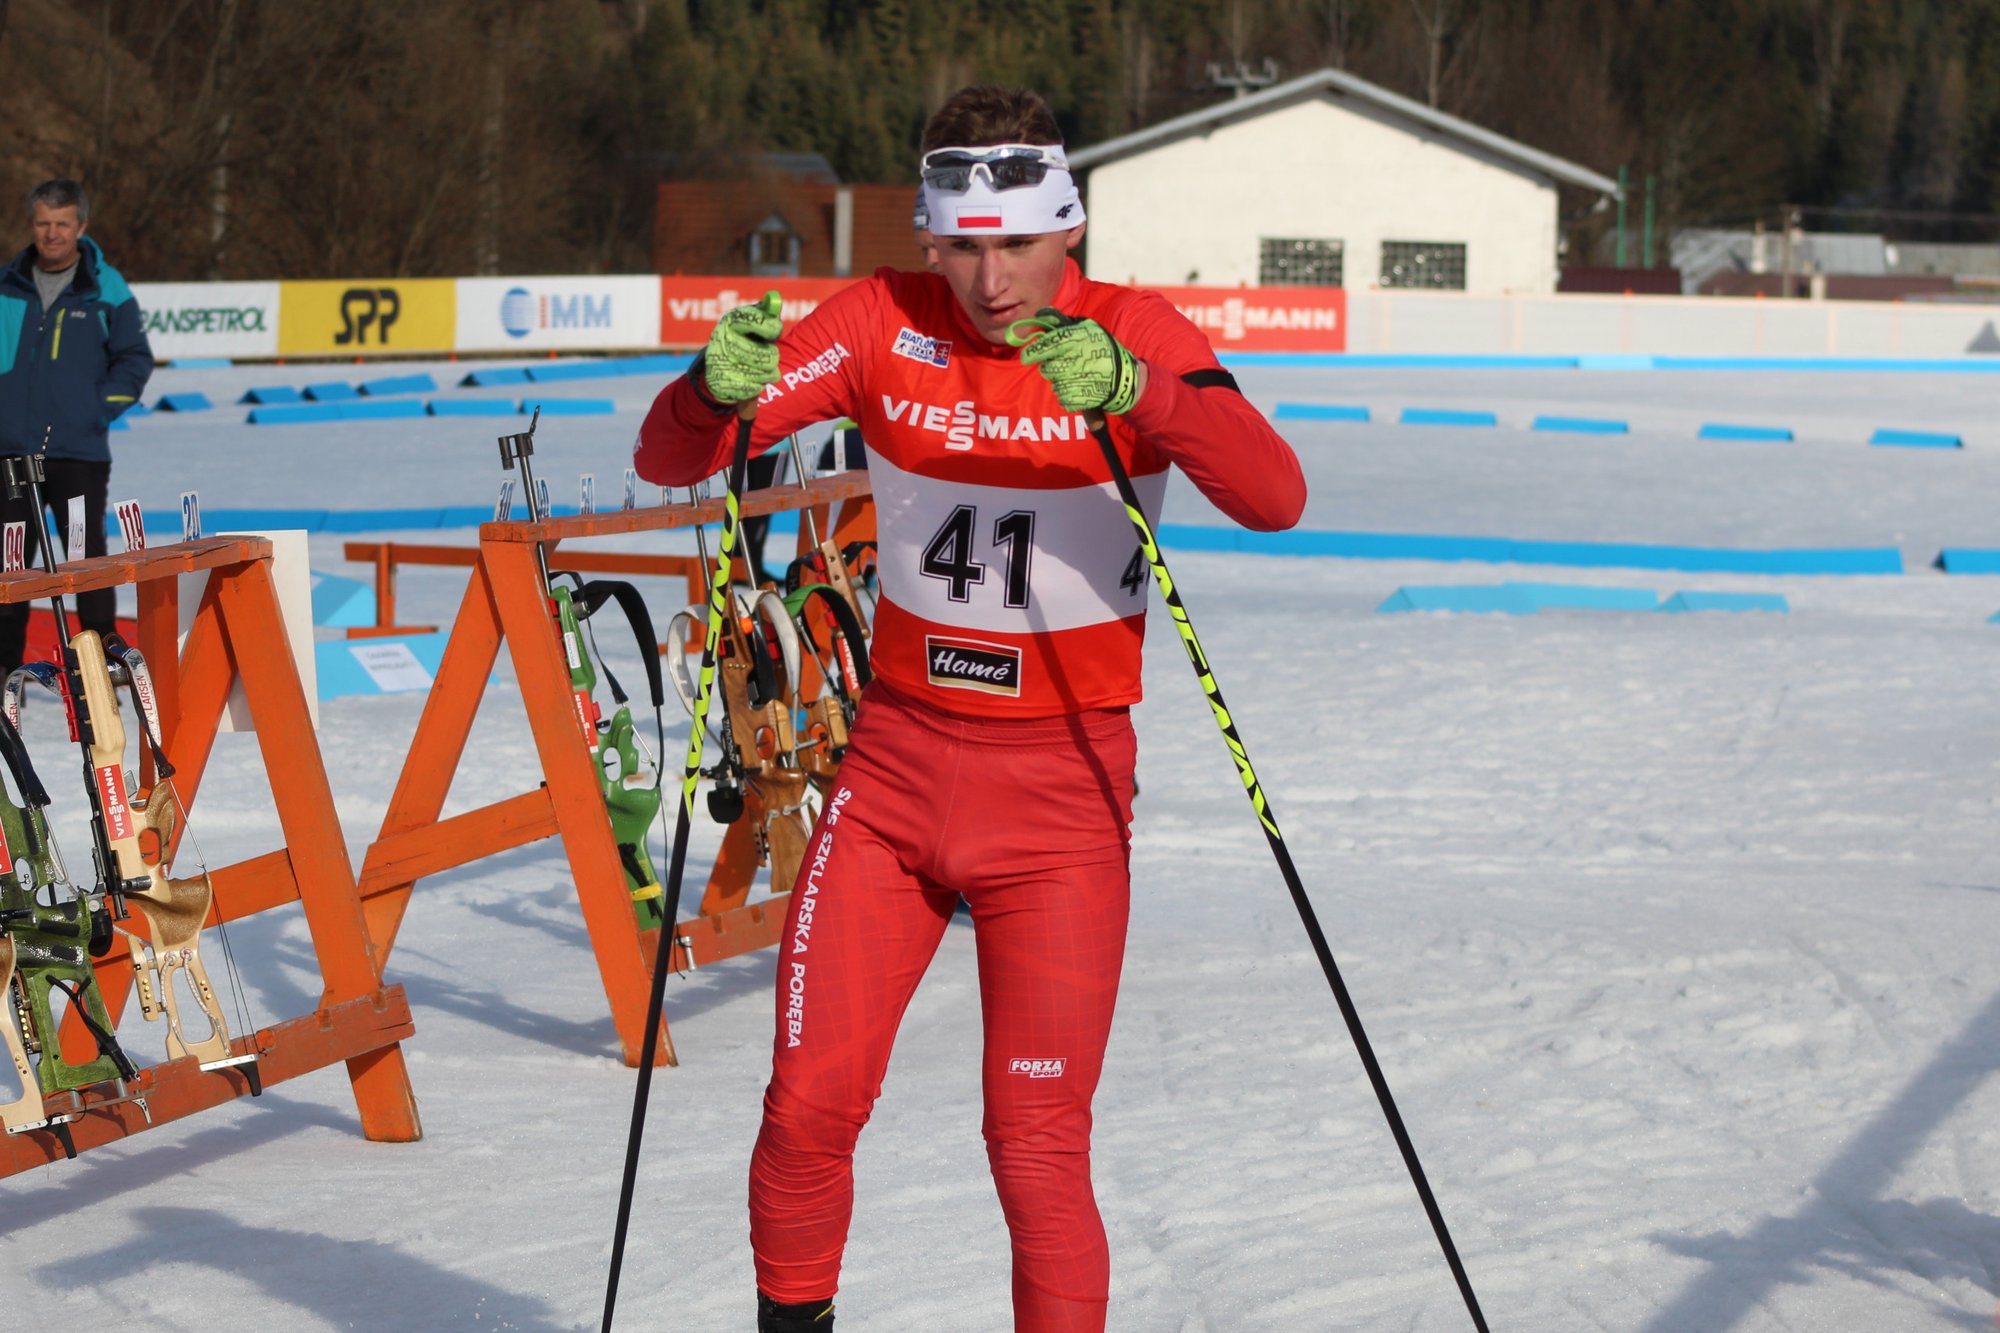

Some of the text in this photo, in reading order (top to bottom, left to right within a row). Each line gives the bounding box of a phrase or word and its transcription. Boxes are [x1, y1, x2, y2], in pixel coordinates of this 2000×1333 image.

[1056, 204, 1074, 219] 4F
[335, 288, 400, 345] SPP
[540, 294, 612, 329] IMM
[920, 503, 1036, 609] 41
[934, 650, 1011, 680] Hamé
[138, 675, 154, 712] LARSEN
[103, 767, 125, 837] VIESSMANN
[786, 787, 852, 1048] SMS SZKLARSKA PORĘBA
[1011, 1060, 1062, 1071] FORZA
